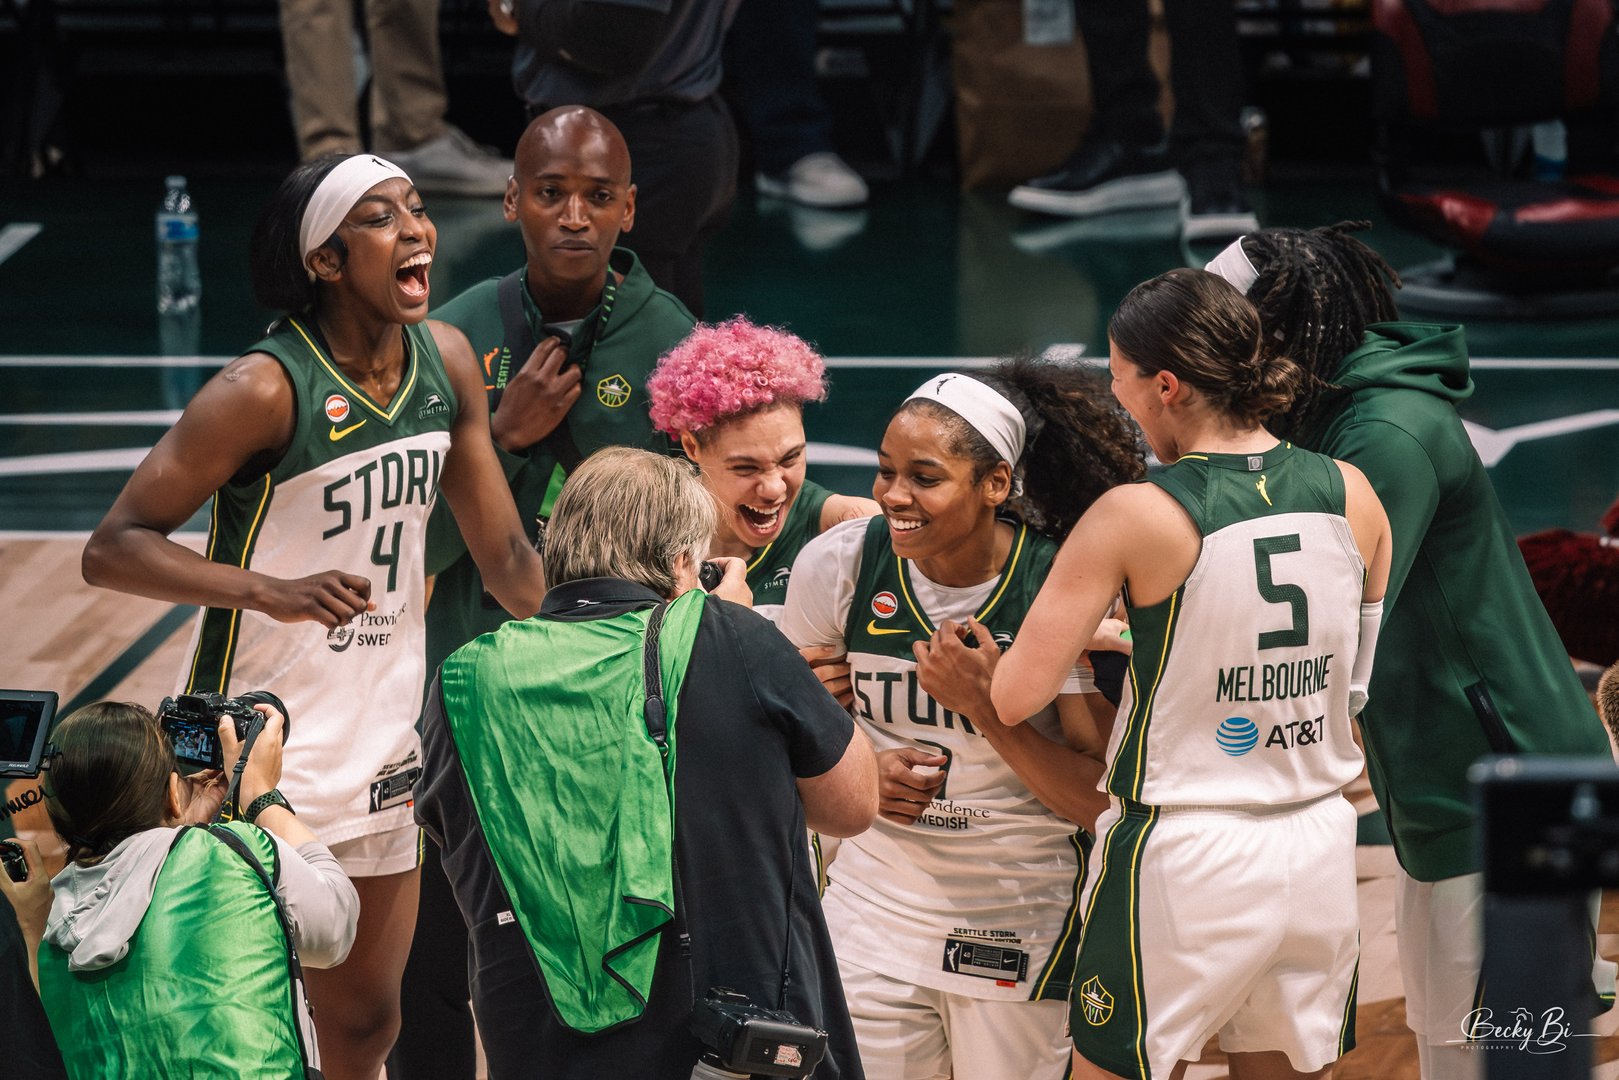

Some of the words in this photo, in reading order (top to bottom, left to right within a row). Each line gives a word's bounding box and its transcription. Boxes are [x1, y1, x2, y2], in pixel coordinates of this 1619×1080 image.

[418, 405, 449, 420] SYMETRA
[370, 521, 404, 593] 4
[1253, 533, 1309, 650] 5
[1216, 654, 1334, 703] MELBOURNE
[1265, 714, 1325, 750] AT&T
[917, 814, 968, 829] WEDISH
[953, 927, 987, 936] SEATTLE
[990, 930, 1016, 938] STORM
